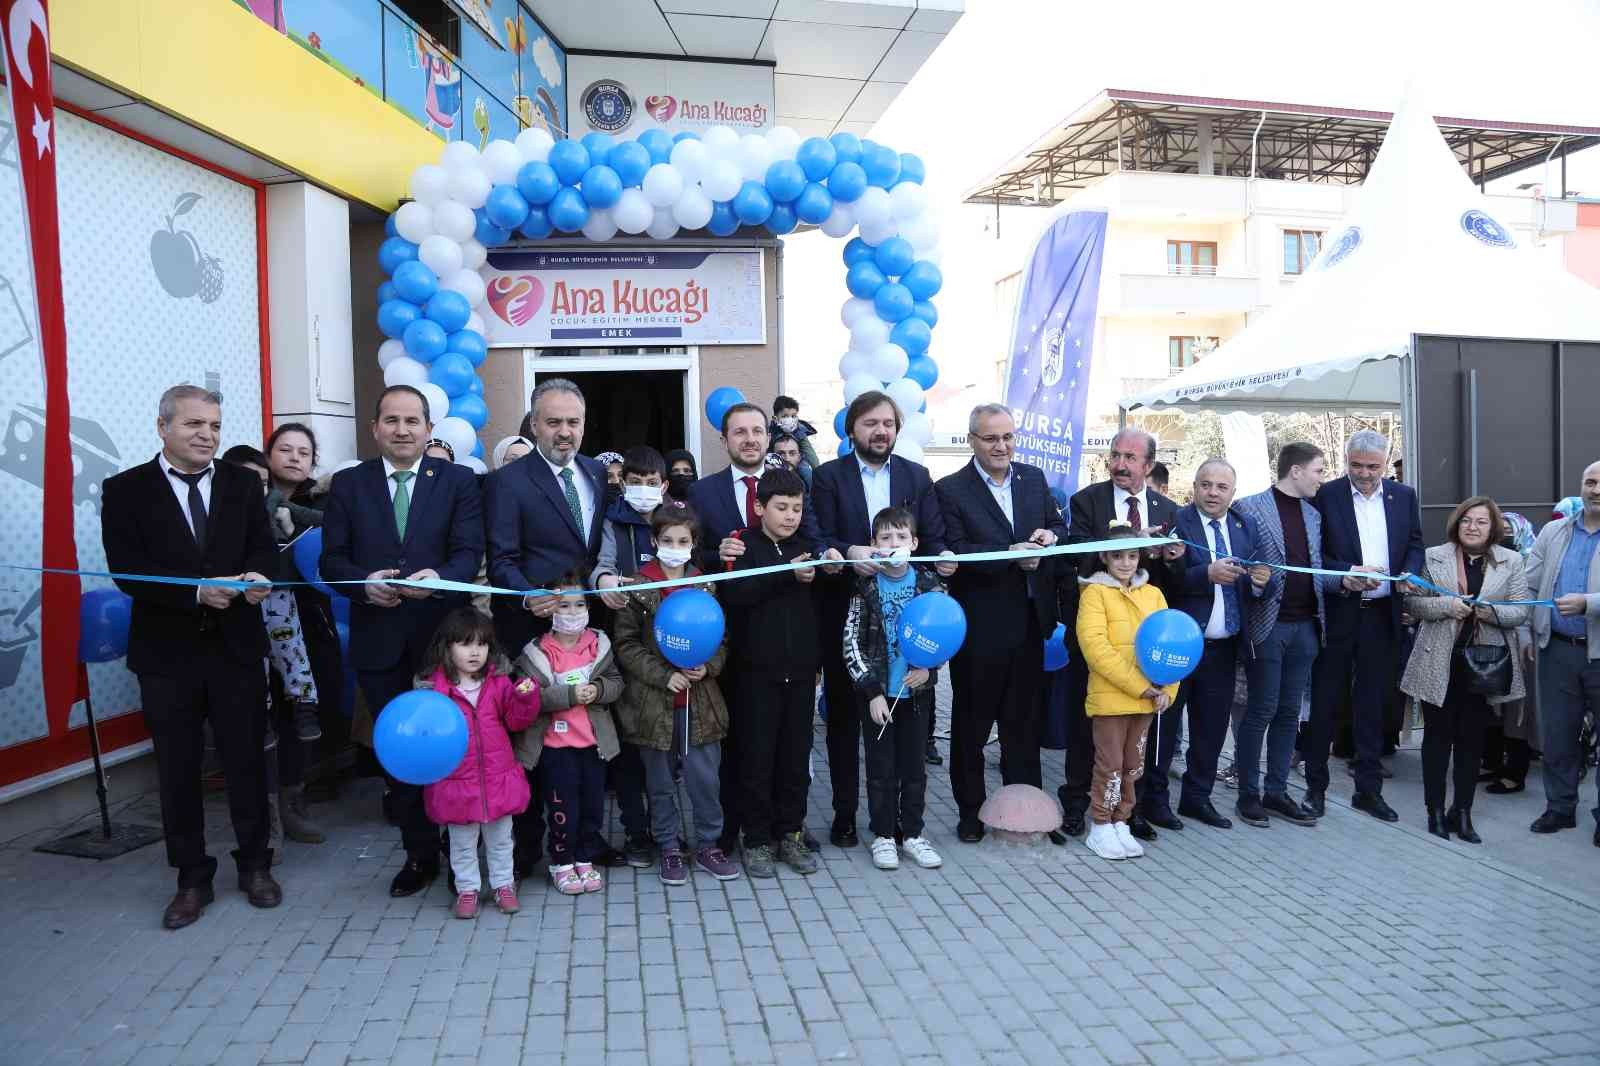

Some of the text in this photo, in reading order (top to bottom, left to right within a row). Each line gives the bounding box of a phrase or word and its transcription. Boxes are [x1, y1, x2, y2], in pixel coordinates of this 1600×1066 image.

[680, 101, 768, 128] Ana Kucağı
[550, 279, 709, 324] Ana Kucağı
[601, 329, 633, 337] EMEK
[1012, 408, 1073, 442] BURSA
[1013, 432, 1072, 457] ÜYÜKŞEHİR
[1012, 451, 1071, 476] ELEDİYESİ
